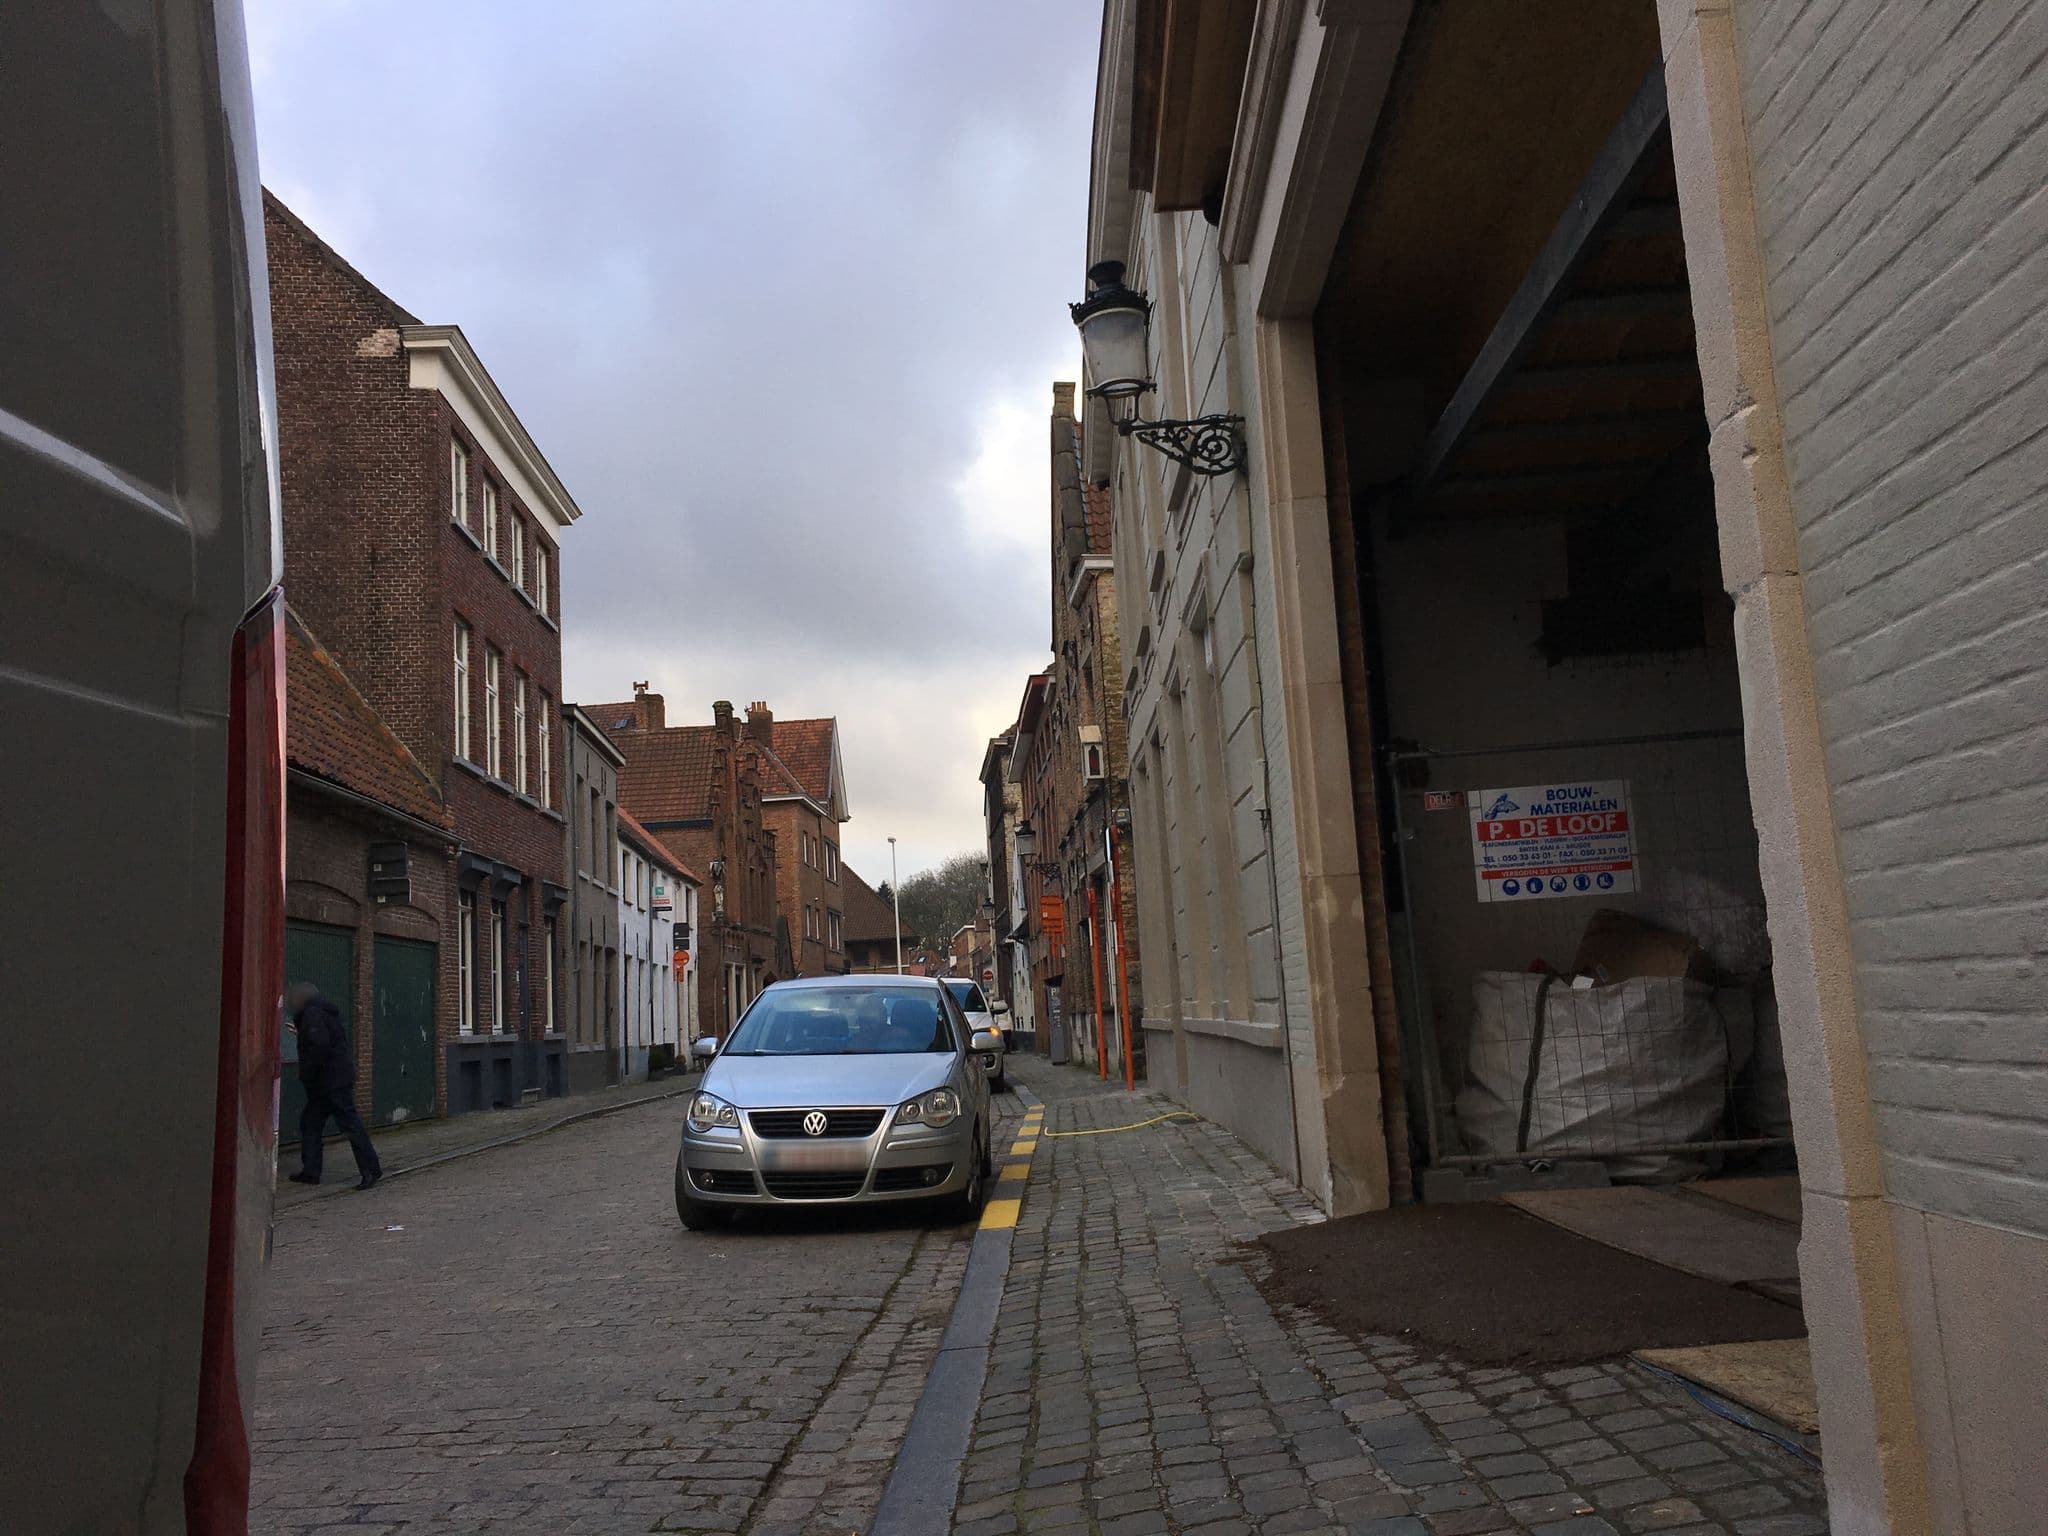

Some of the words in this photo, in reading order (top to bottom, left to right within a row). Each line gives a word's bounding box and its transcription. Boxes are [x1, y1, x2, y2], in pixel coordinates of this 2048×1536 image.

[1546, 787, 1599, 801] BOUW-
[1530, 798, 1618, 816] MATERIALEN
[1489, 821, 1511, 840] P.
[1519, 818, 1548, 838] DE
[1556, 813, 1617, 835] LOOF
[1051, 987, 1057, 996] P
